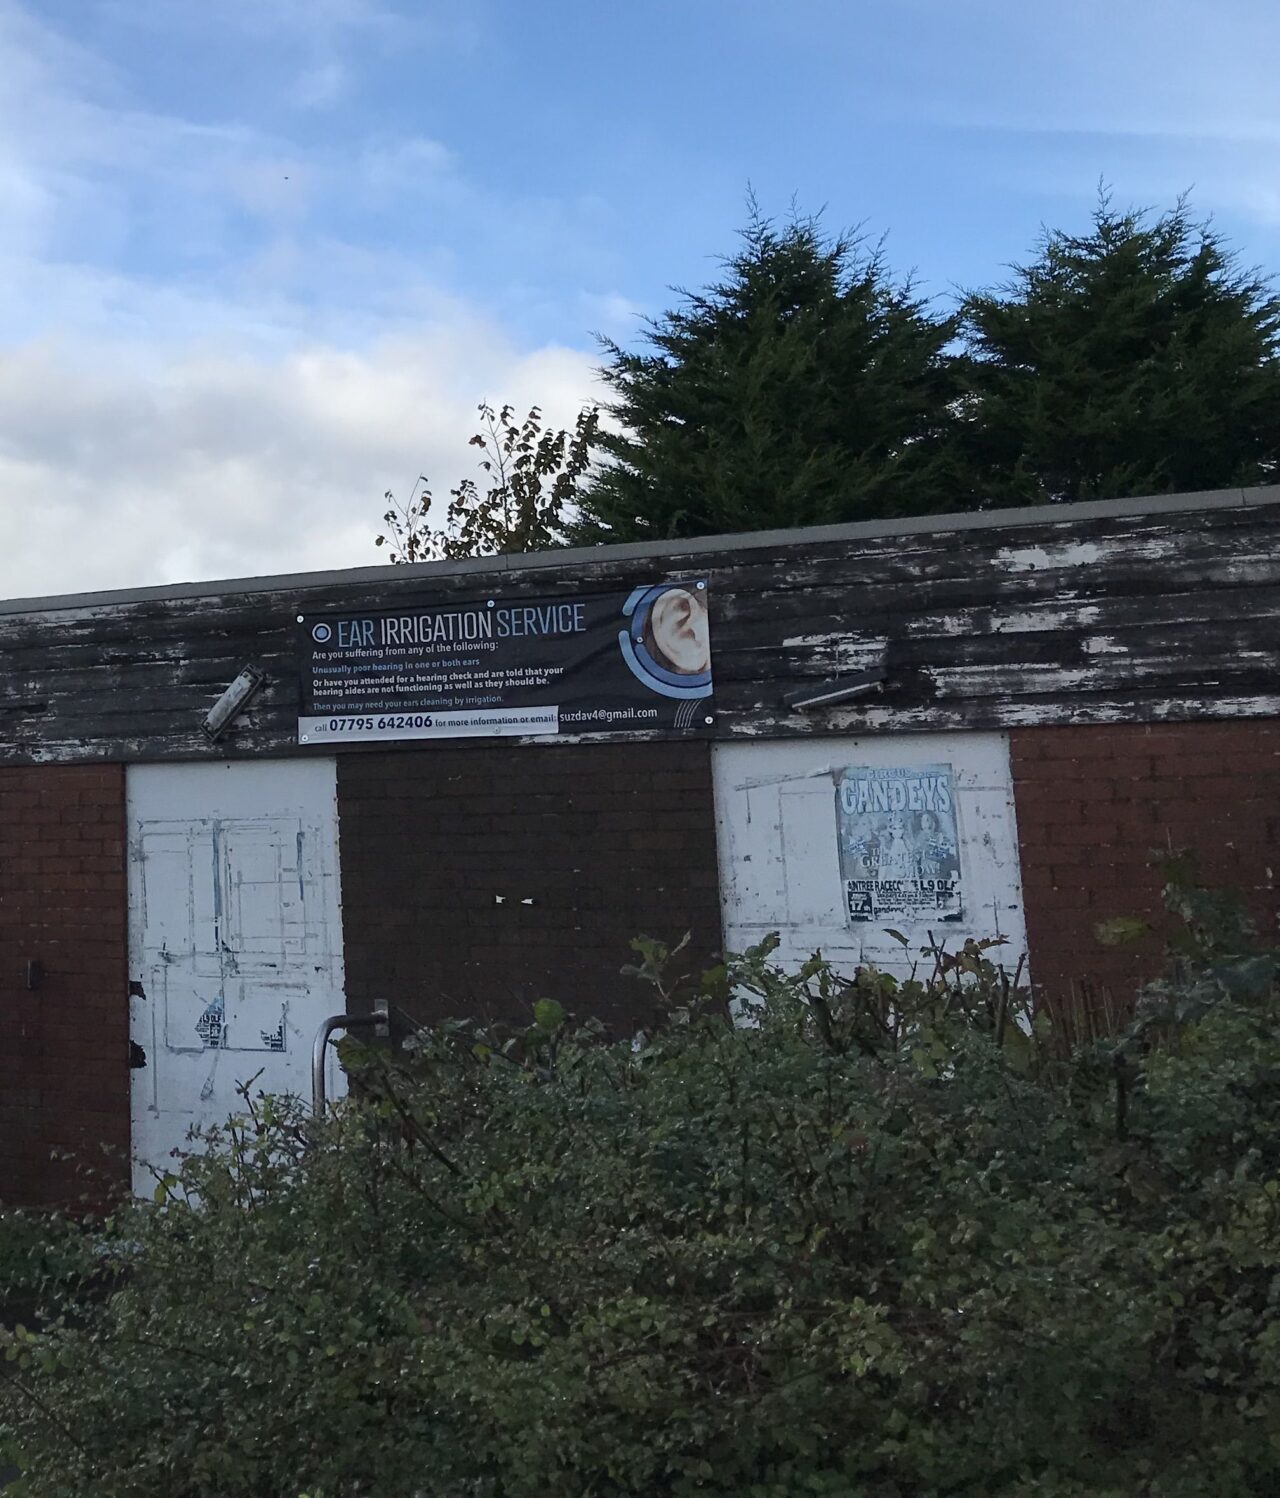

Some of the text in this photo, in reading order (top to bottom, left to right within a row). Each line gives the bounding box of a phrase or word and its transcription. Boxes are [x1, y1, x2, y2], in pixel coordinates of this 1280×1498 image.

[338, 604, 586, 647] EAR IRRIGATION SERVICE
[312, 641, 499, 661] Are you suffering from any of the following:
[312, 664, 351, 674] Unusually
[353, 665, 370, 674] poor
[372, 663, 403, 672] hearing
[415, 661, 430, 669] one
[442, 658, 460, 667] both
[462, 658, 480, 666] ears
[313, 688, 343, 697] hearing
[345, 686, 366, 695] aides
[381, 685, 394, 693] not
[395, 682, 442, 693] functioning
[454, 680, 472, 689] well
[474, 681, 484, 689] as
[485, 679, 503, 689] they
[505, 677, 534, 686] should
[536, 676, 550, 685] be.
[324, 679, 343, 687] have
[344, 679, 359, 688] you
[360, 676, 395, 685] attended
[396, 675, 409, 683] for
[416, 672, 448, 683] hearing
[449, 671, 472, 680] check
[473, 669, 489, 679] and
[491, 670, 505, 678] are
[506, 668, 523, 677] told
[525, 667, 543, 676] that
[544, 667, 564, 677] your
[313, 695, 504, 712] Then you may need your ears cleaning by irrigation.
[314, 725, 327, 733] call
[329, 718, 374, 731] 07795
[377, 715, 433, 729] 642406
[435, 719, 447, 727] for
[448, 718, 469, 727] more
[470, 716, 518, 726] information
[560, 708, 658, 722] suzdav4@gmail.com
[839, 775, 951, 815] GANDEYS
